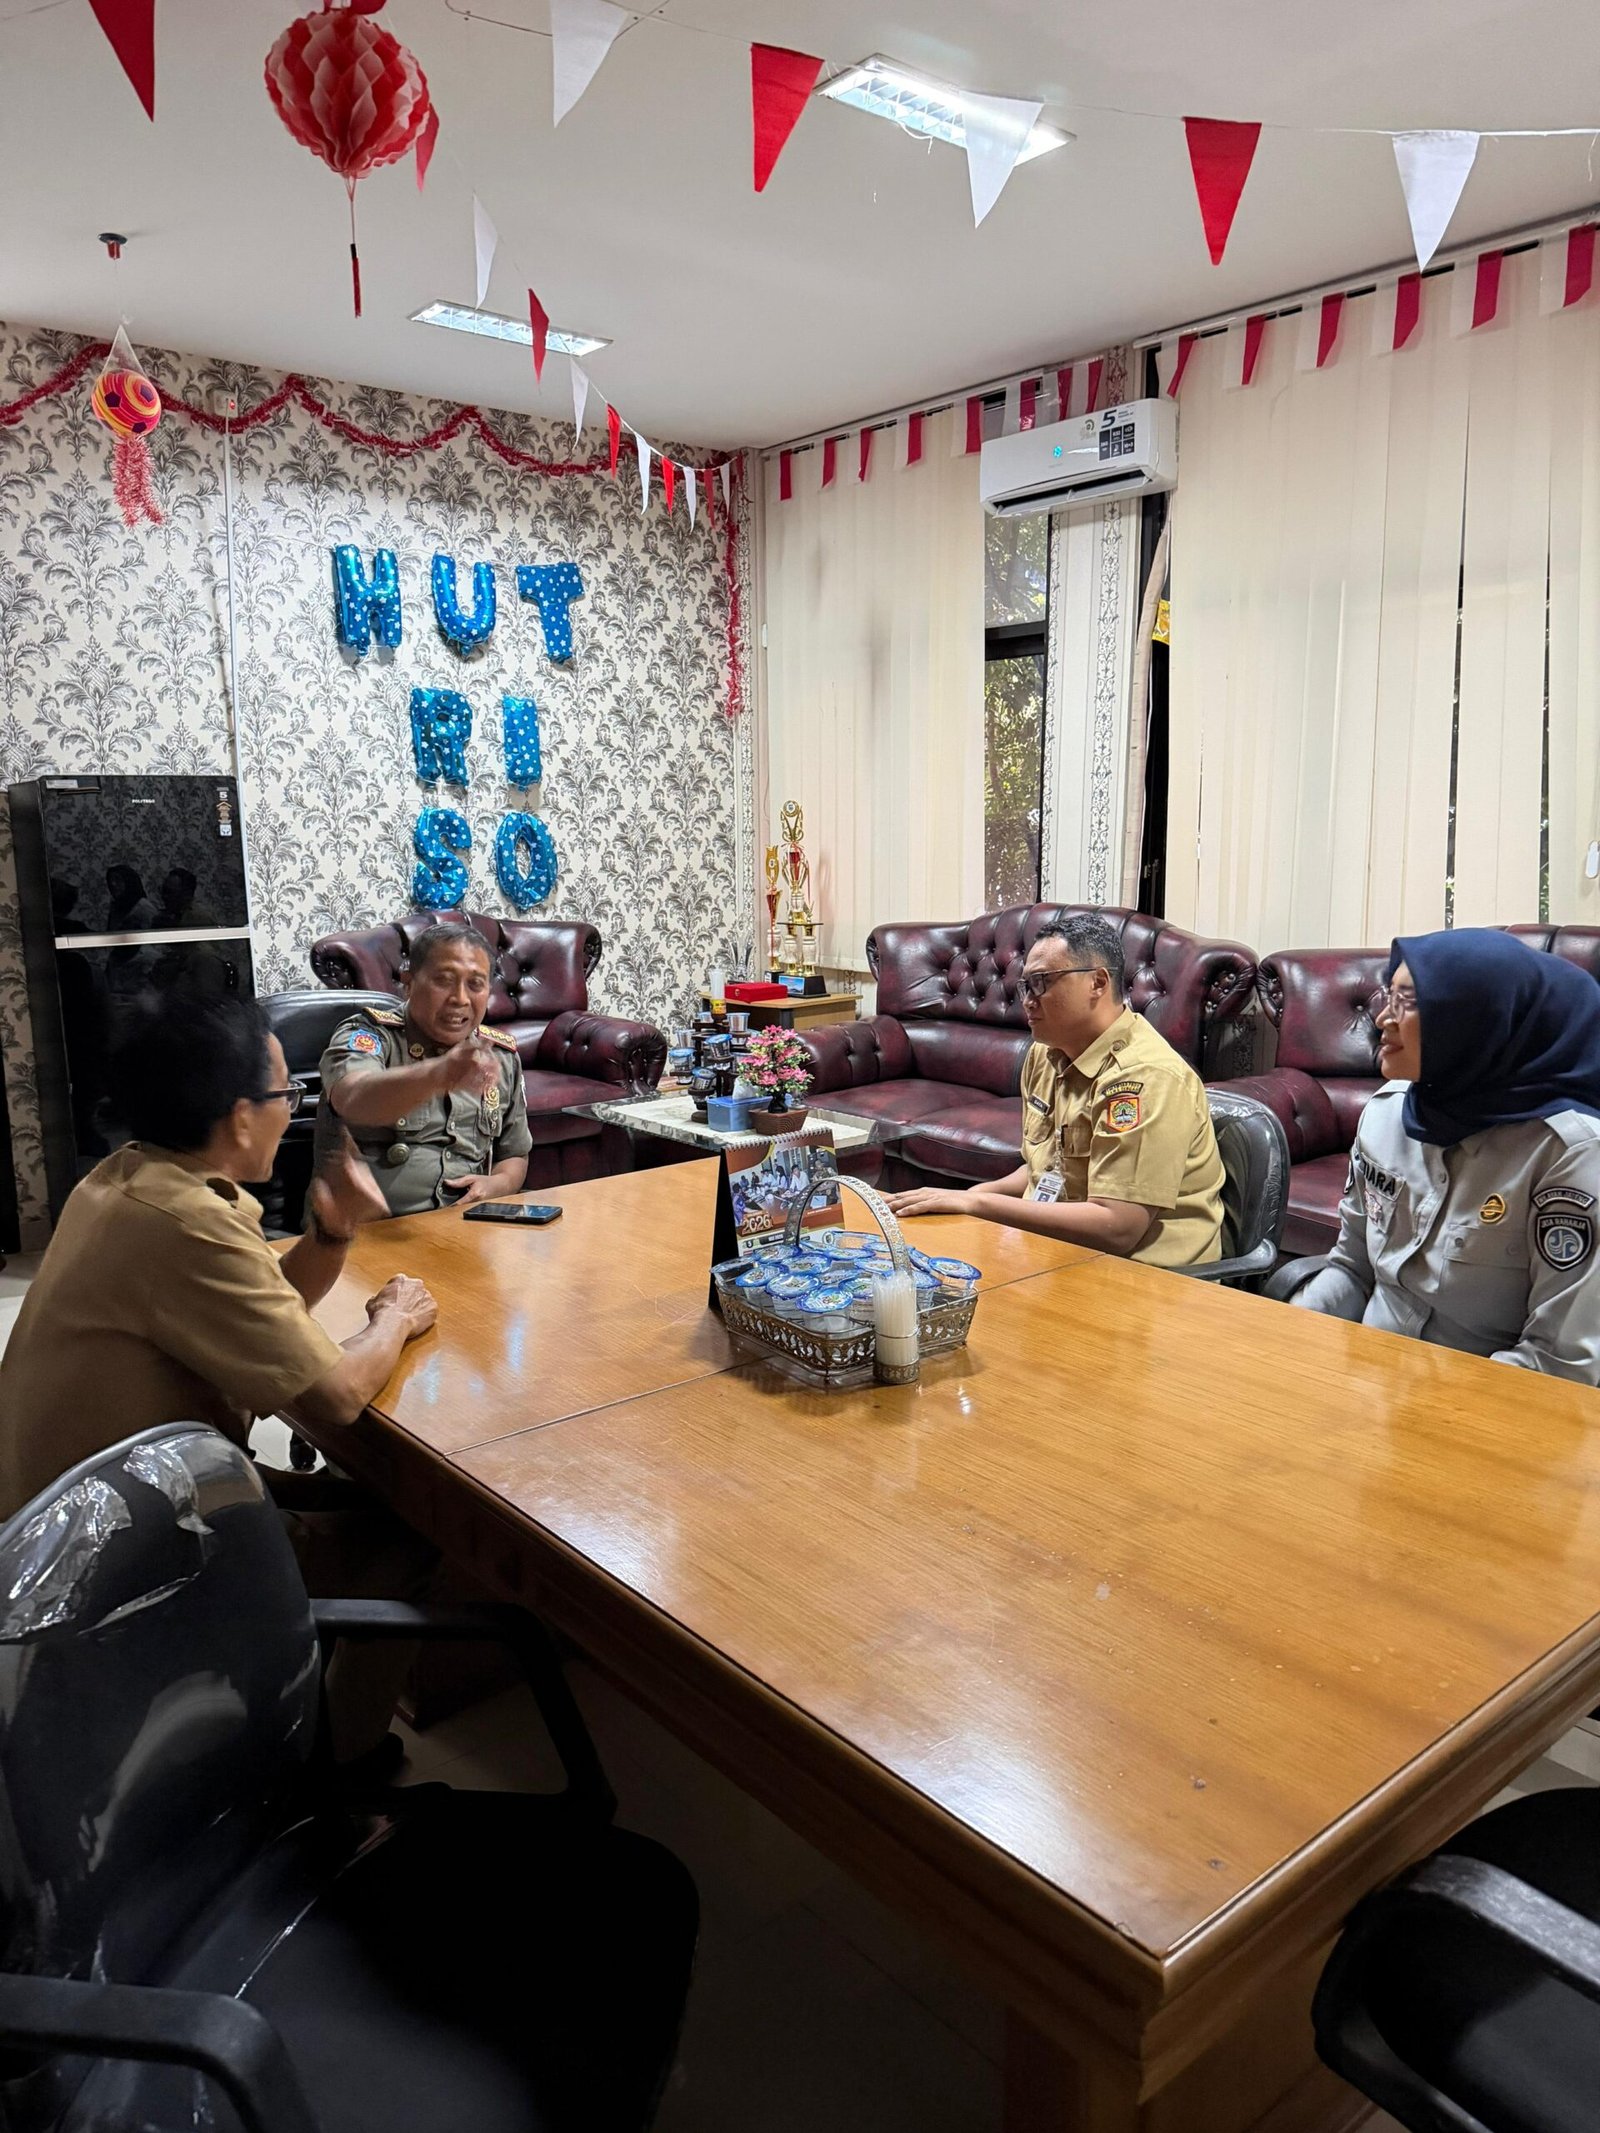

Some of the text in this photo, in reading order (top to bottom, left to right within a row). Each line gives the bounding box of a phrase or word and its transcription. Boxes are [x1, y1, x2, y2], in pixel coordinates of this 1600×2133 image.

[1100, 409, 1118, 429] 5
[334, 543, 585, 664] HUT
[410, 686, 543, 792] RI
[741, 1213, 772, 1236] 2026
